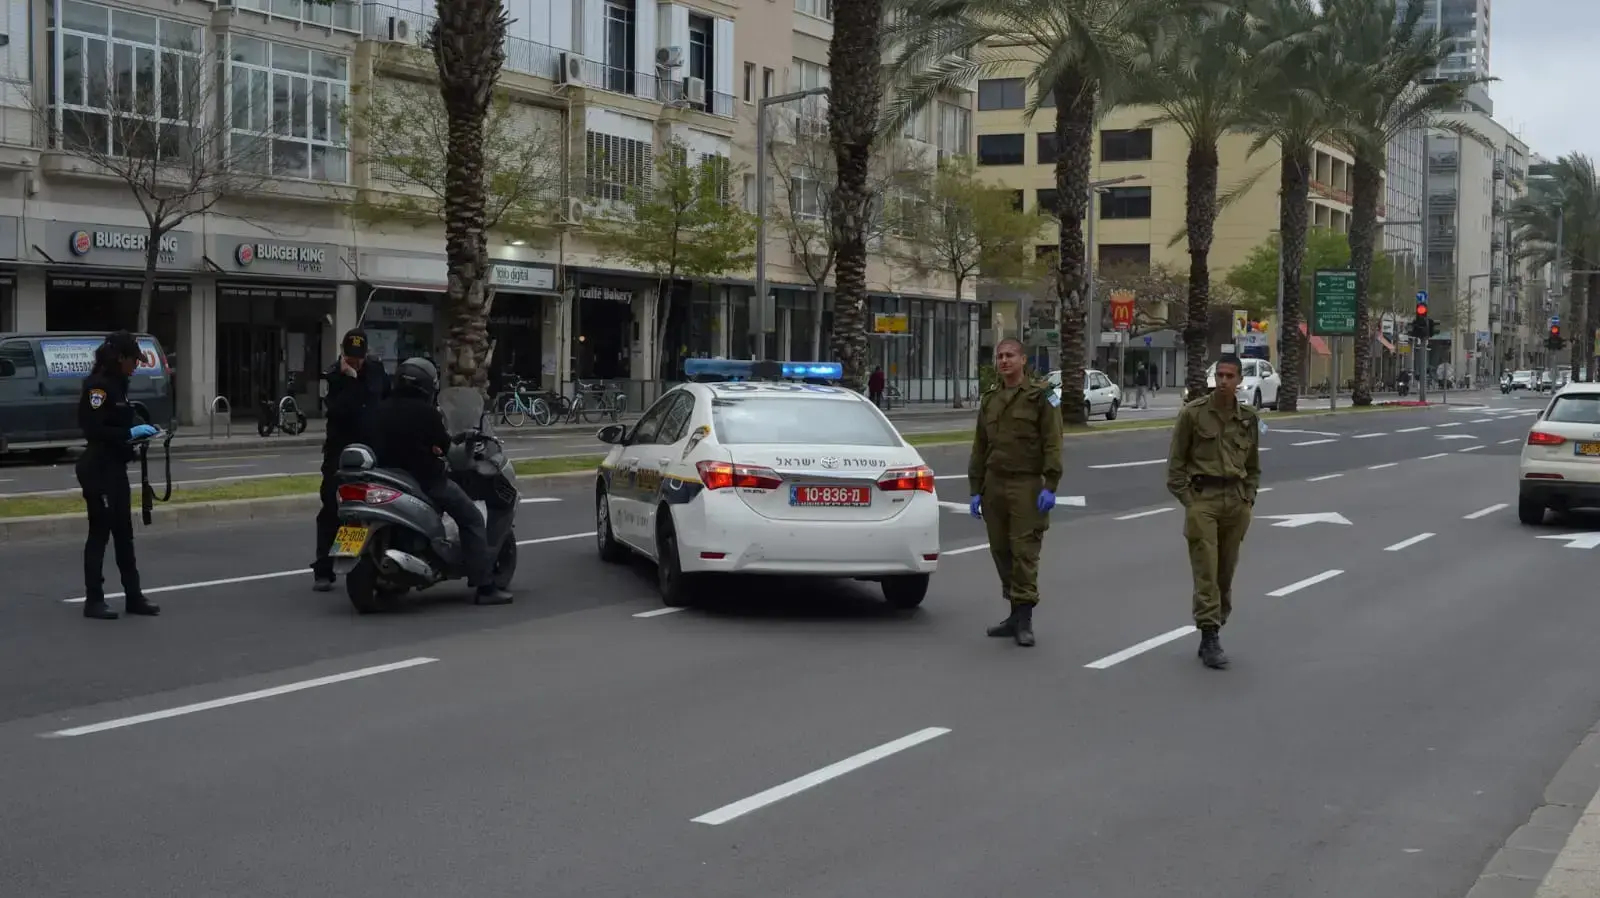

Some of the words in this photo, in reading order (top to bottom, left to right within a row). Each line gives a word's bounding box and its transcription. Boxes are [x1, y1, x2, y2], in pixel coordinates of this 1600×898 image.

[95, 231, 146, 250] BURGER
[257, 244, 299, 260] BURGER
[300, 247, 325, 263] KING
[775, 456, 816, 467] ישראל
[843, 457, 887, 468] משטרת
